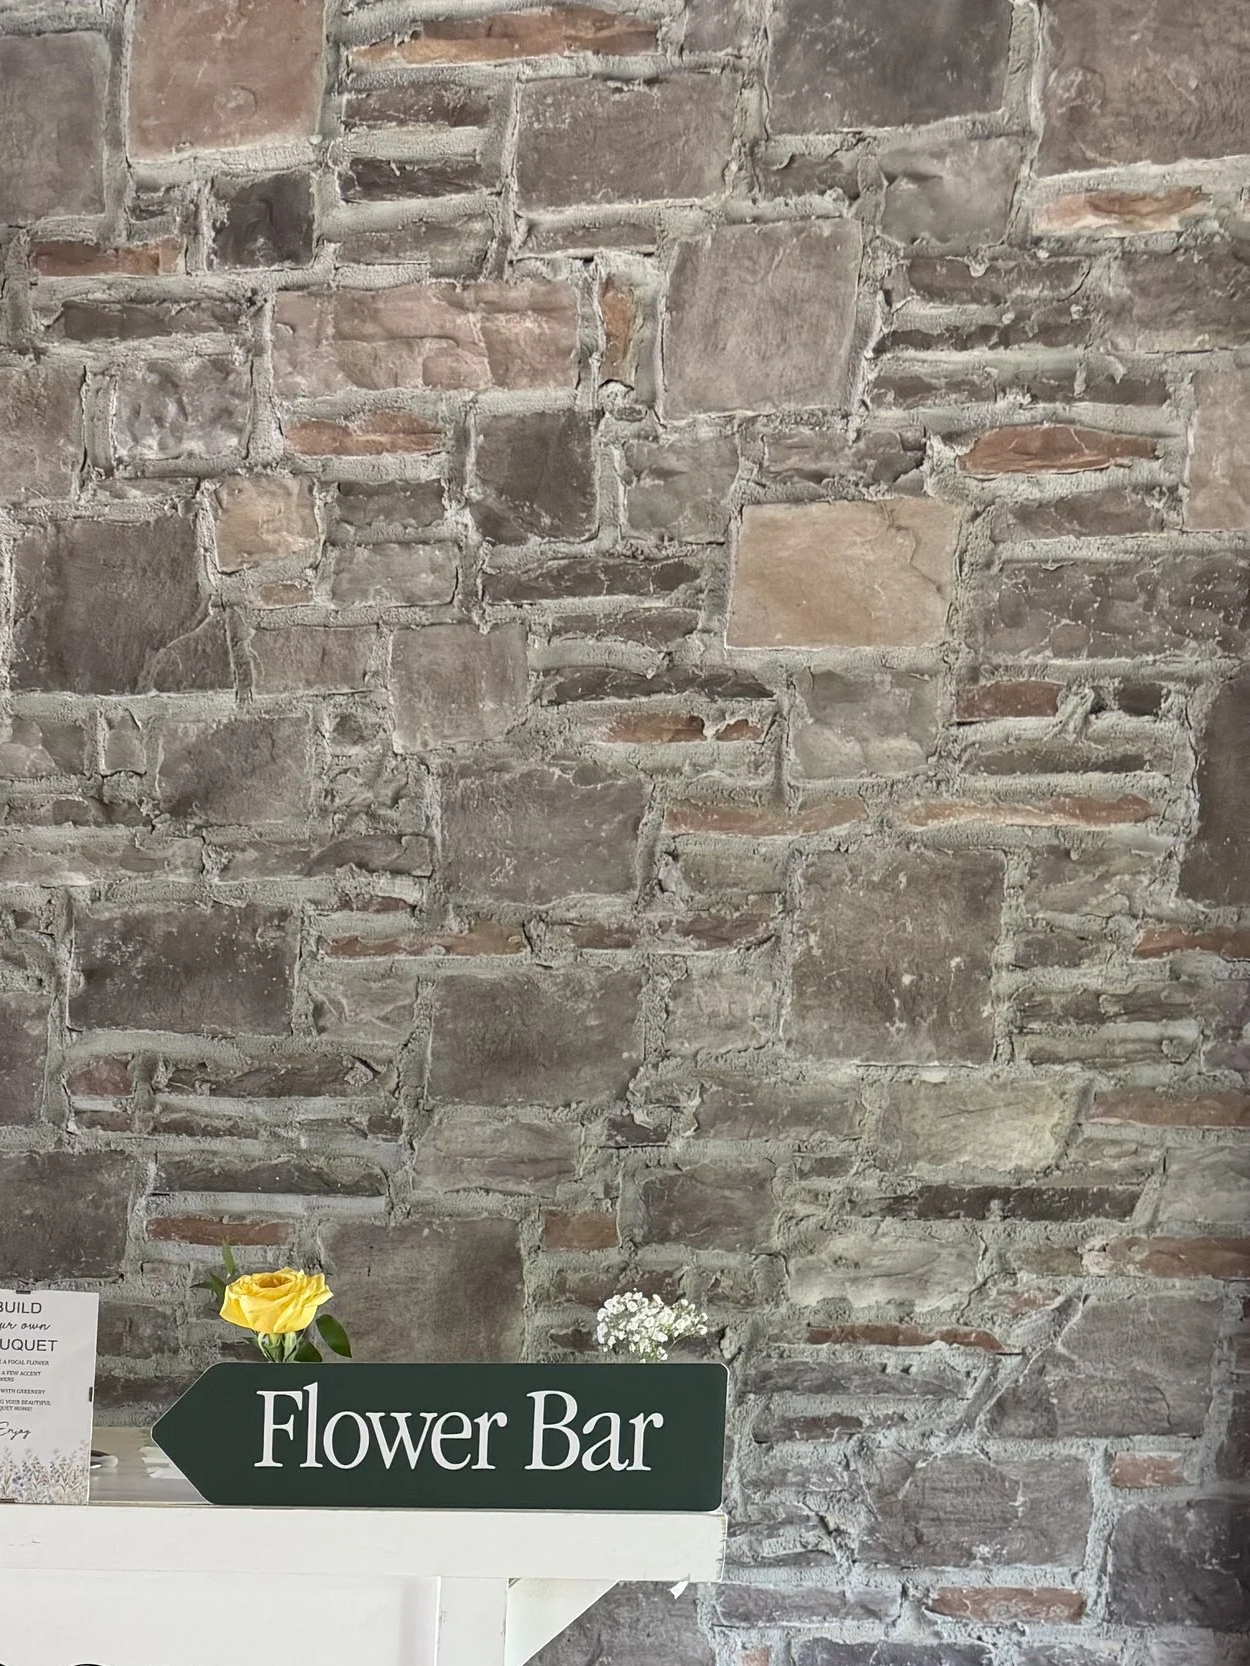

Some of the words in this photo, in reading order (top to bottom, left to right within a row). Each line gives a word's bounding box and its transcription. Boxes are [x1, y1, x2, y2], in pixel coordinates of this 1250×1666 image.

[20, 1322, 51, 1331] own
[254, 1382, 507, 1470] Flower
[524, 1390, 664, 1472] Bar
